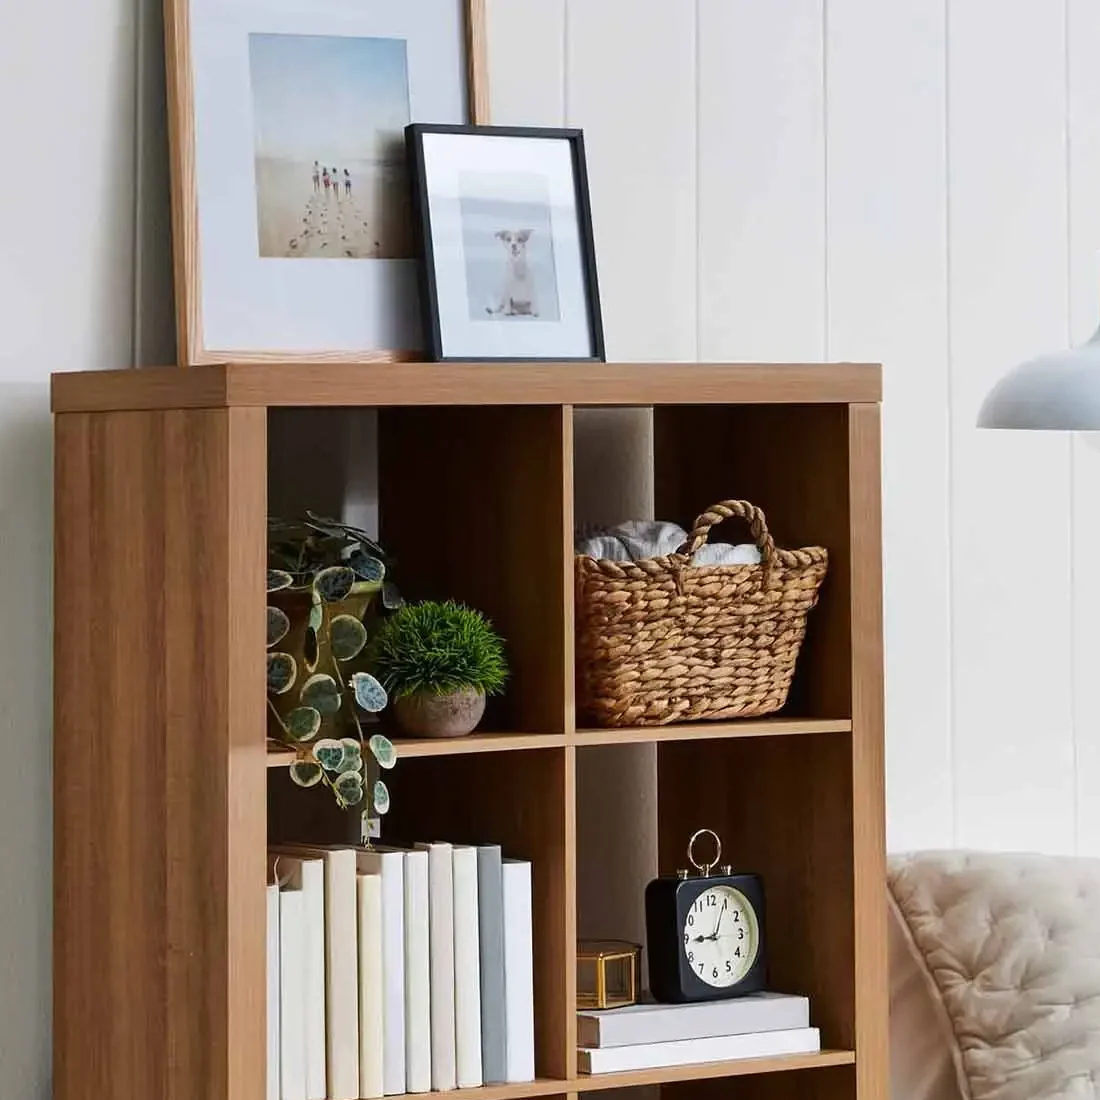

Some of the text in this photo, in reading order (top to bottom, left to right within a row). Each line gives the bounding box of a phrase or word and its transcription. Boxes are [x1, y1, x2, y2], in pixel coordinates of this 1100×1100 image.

[706, 894, 716, 906] 12
[694, 902, 702, 912] 11
[734, 910, 739, 922] 2
[738, 928, 744, 940] 3
[688, 952, 694, 962] 8
[734, 946, 740, 958] 4
[698, 964, 704, 974] 7
[712, 966, 718, 978] 6
[726, 960, 732, 972] 5
